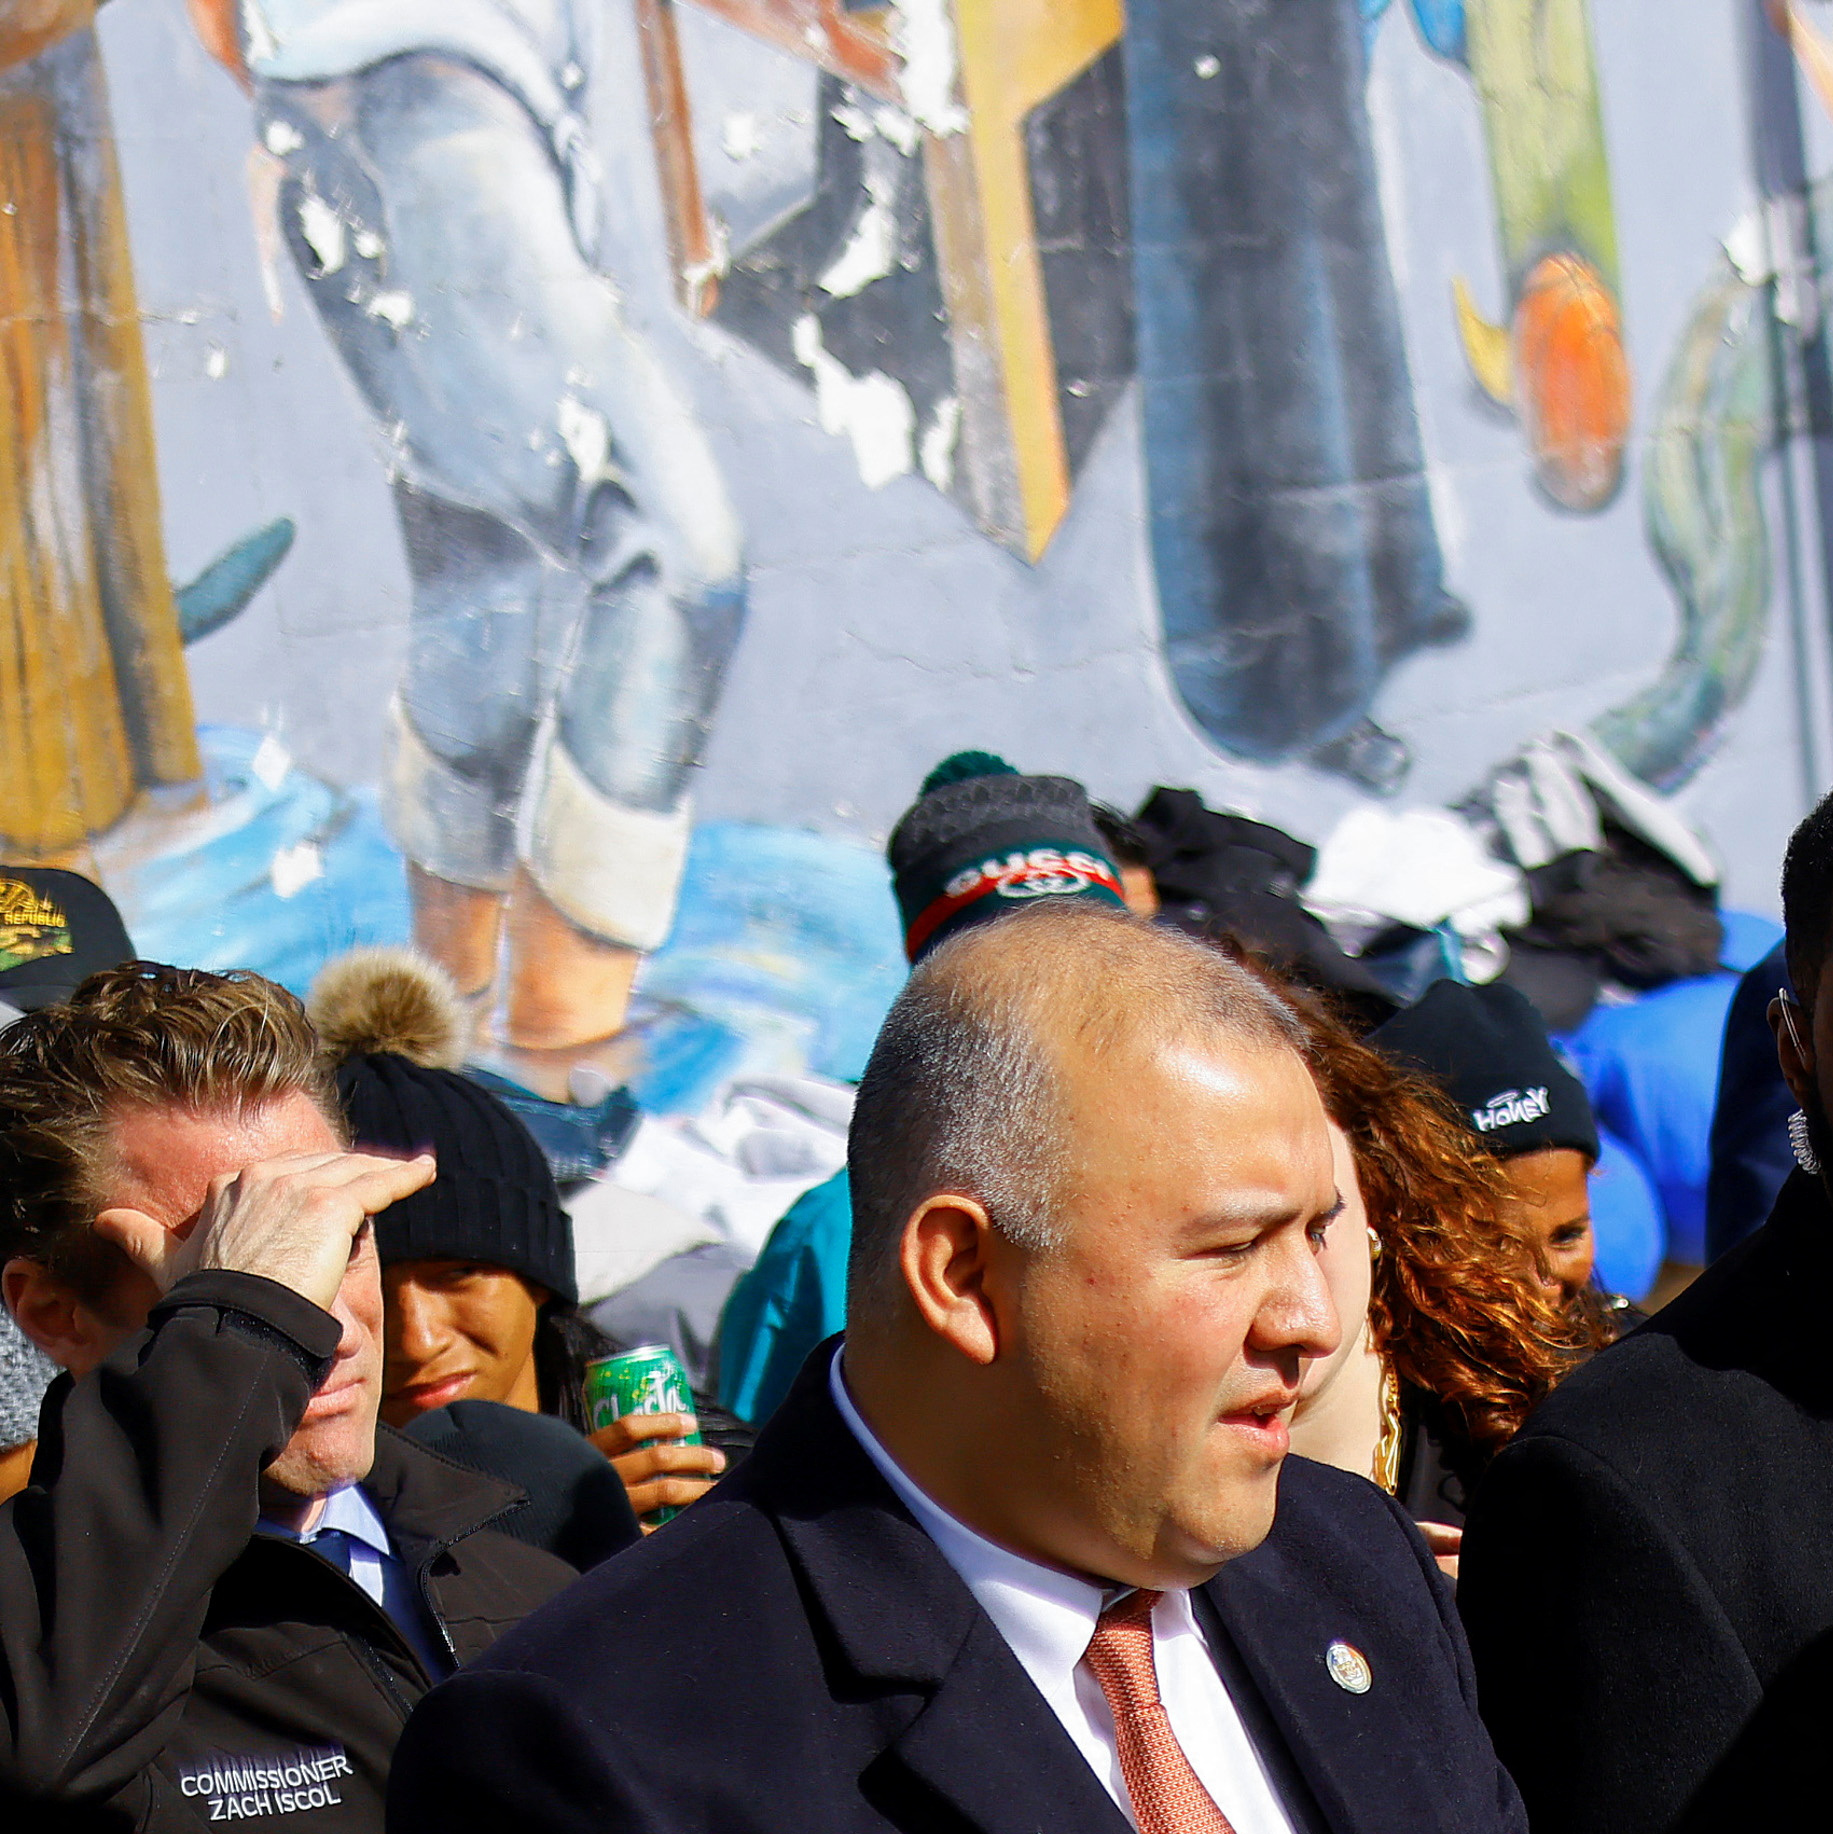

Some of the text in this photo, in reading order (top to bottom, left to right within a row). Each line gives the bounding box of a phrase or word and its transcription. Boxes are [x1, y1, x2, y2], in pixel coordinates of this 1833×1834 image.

[945, 848, 1110, 898] GUCCI
[1473, 1086, 1551, 1132] HONEY
[181, 1754, 353, 1797] COMMISSIONER
[207, 1784, 342, 1821] ZACH ISCOL
